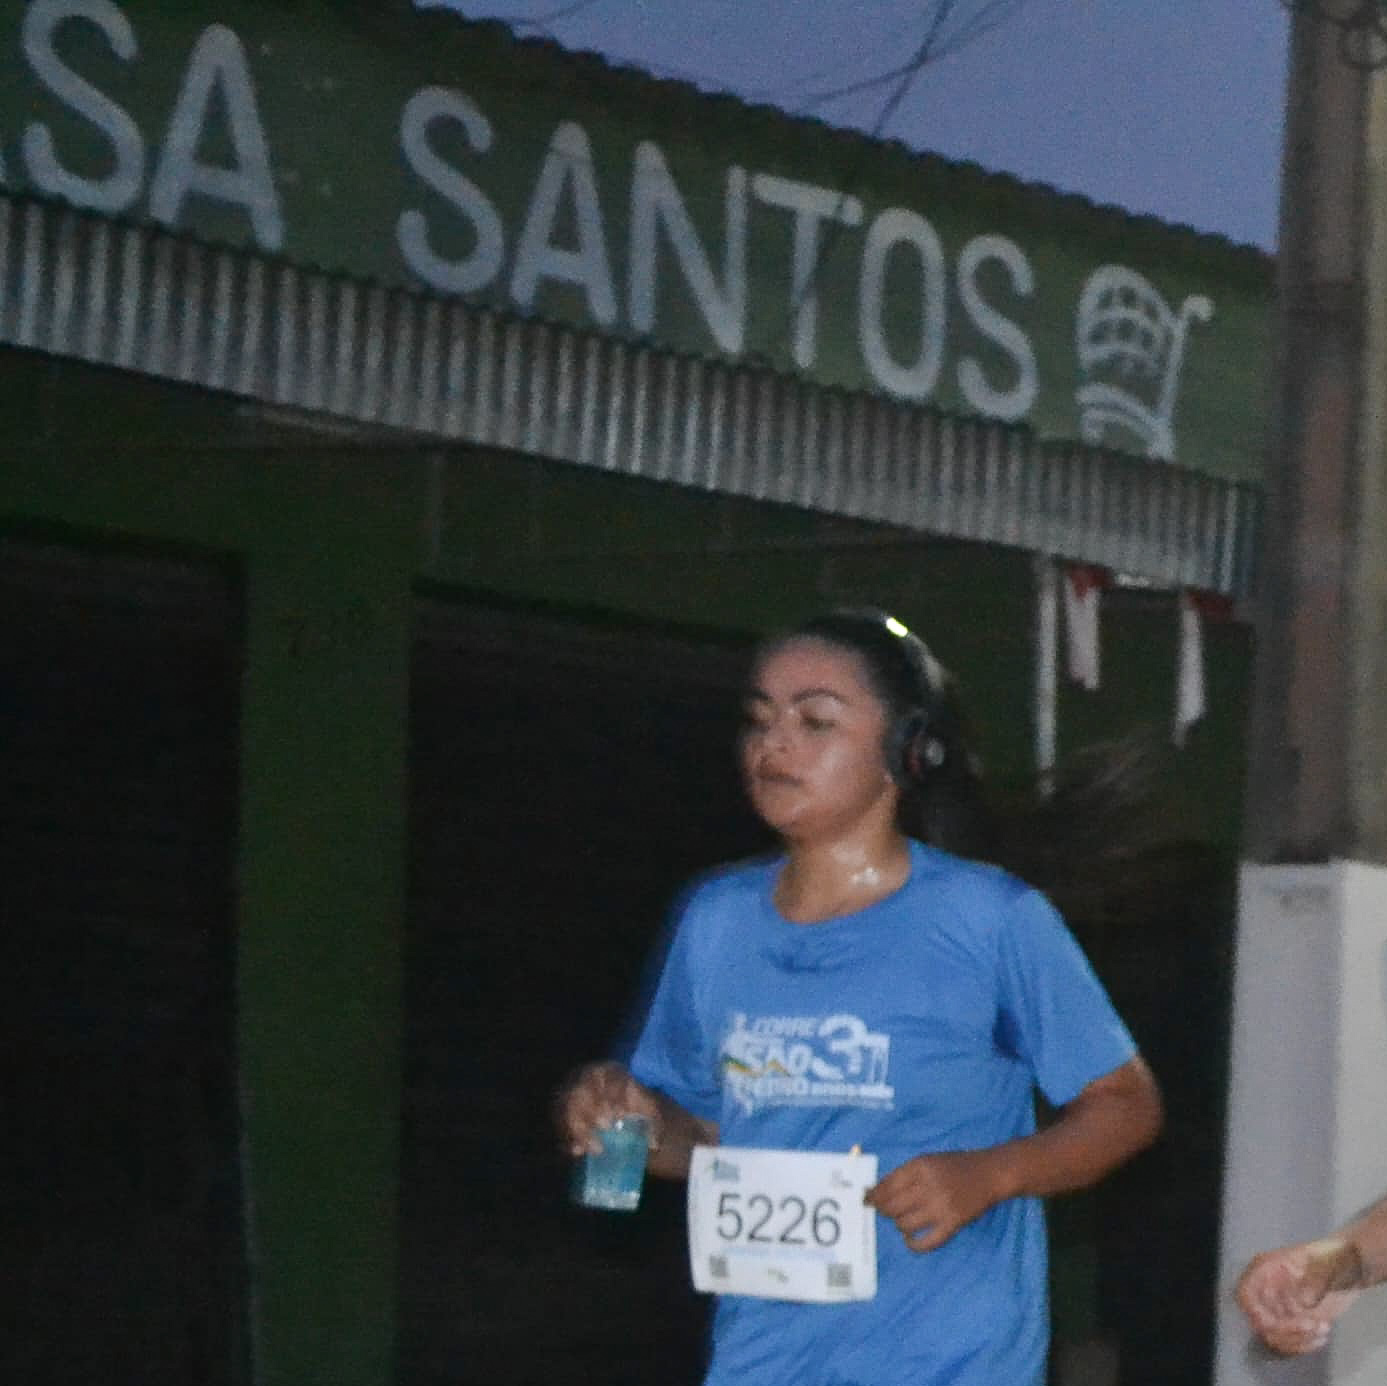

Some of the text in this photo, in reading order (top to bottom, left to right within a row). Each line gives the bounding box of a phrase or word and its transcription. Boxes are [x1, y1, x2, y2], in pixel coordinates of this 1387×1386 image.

[0, 0, 1039, 421] SA SANTOS
[716, 1192, 842, 1247] 5226
